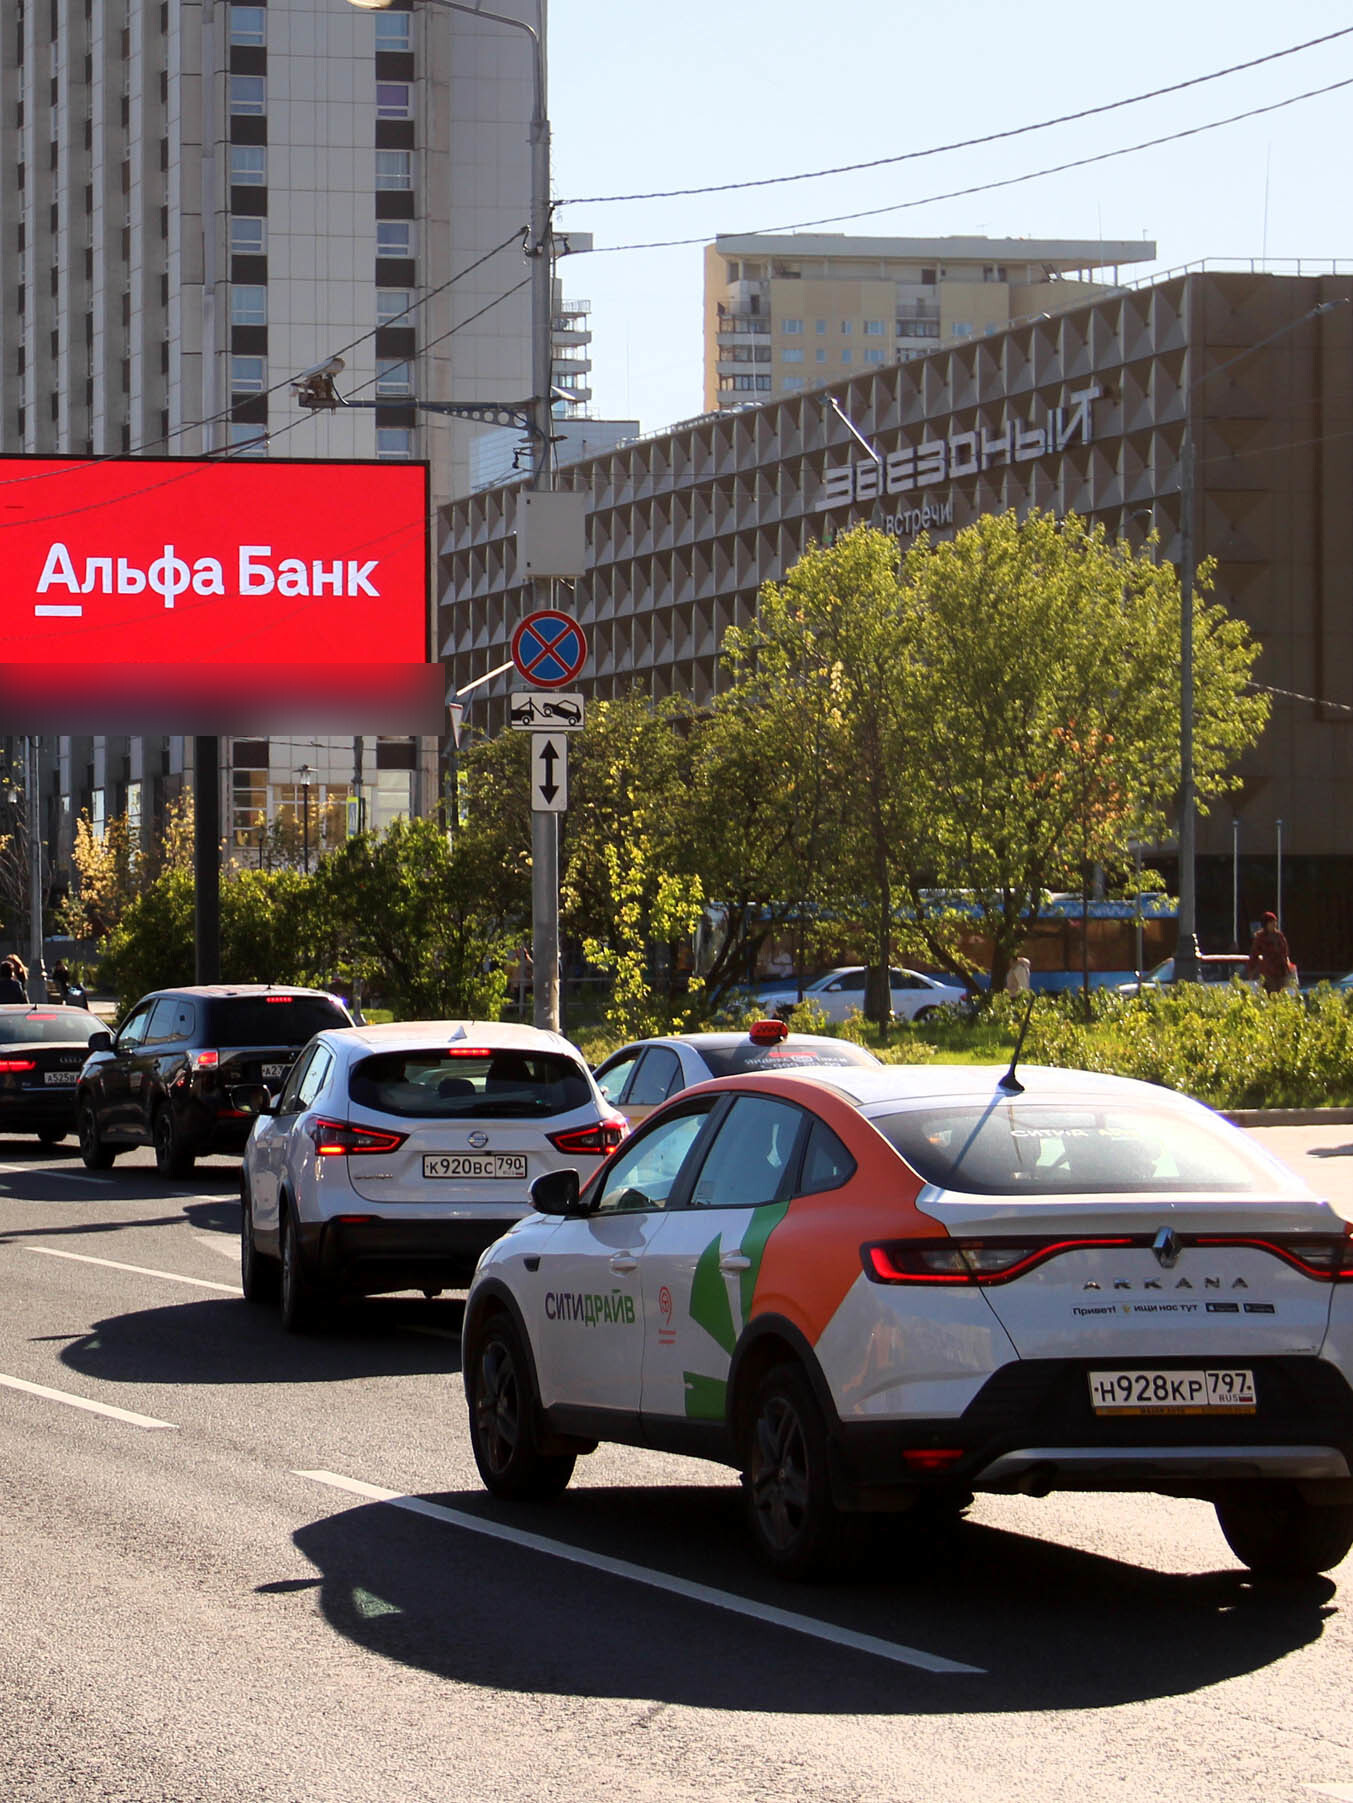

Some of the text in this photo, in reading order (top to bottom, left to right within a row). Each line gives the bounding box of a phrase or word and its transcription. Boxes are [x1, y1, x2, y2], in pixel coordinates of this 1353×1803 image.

[35, 542, 381, 612] Альфа Банк
[429, 1157, 522, 1174] К920ВС 790
[1083, 1277, 1248, 1290] ARKANA
[545, 1288, 636, 1328] СИТИДРАЙВ
[1073, 1305, 1117, 1316] Привет!
[1134, 1303, 1158, 1313] ищи
[1179, 1303, 1198, 1312] тут
[1099, 1372, 1248, 1402] Н928КР 797
[1219, 1393, 1239, 1402] RUS
